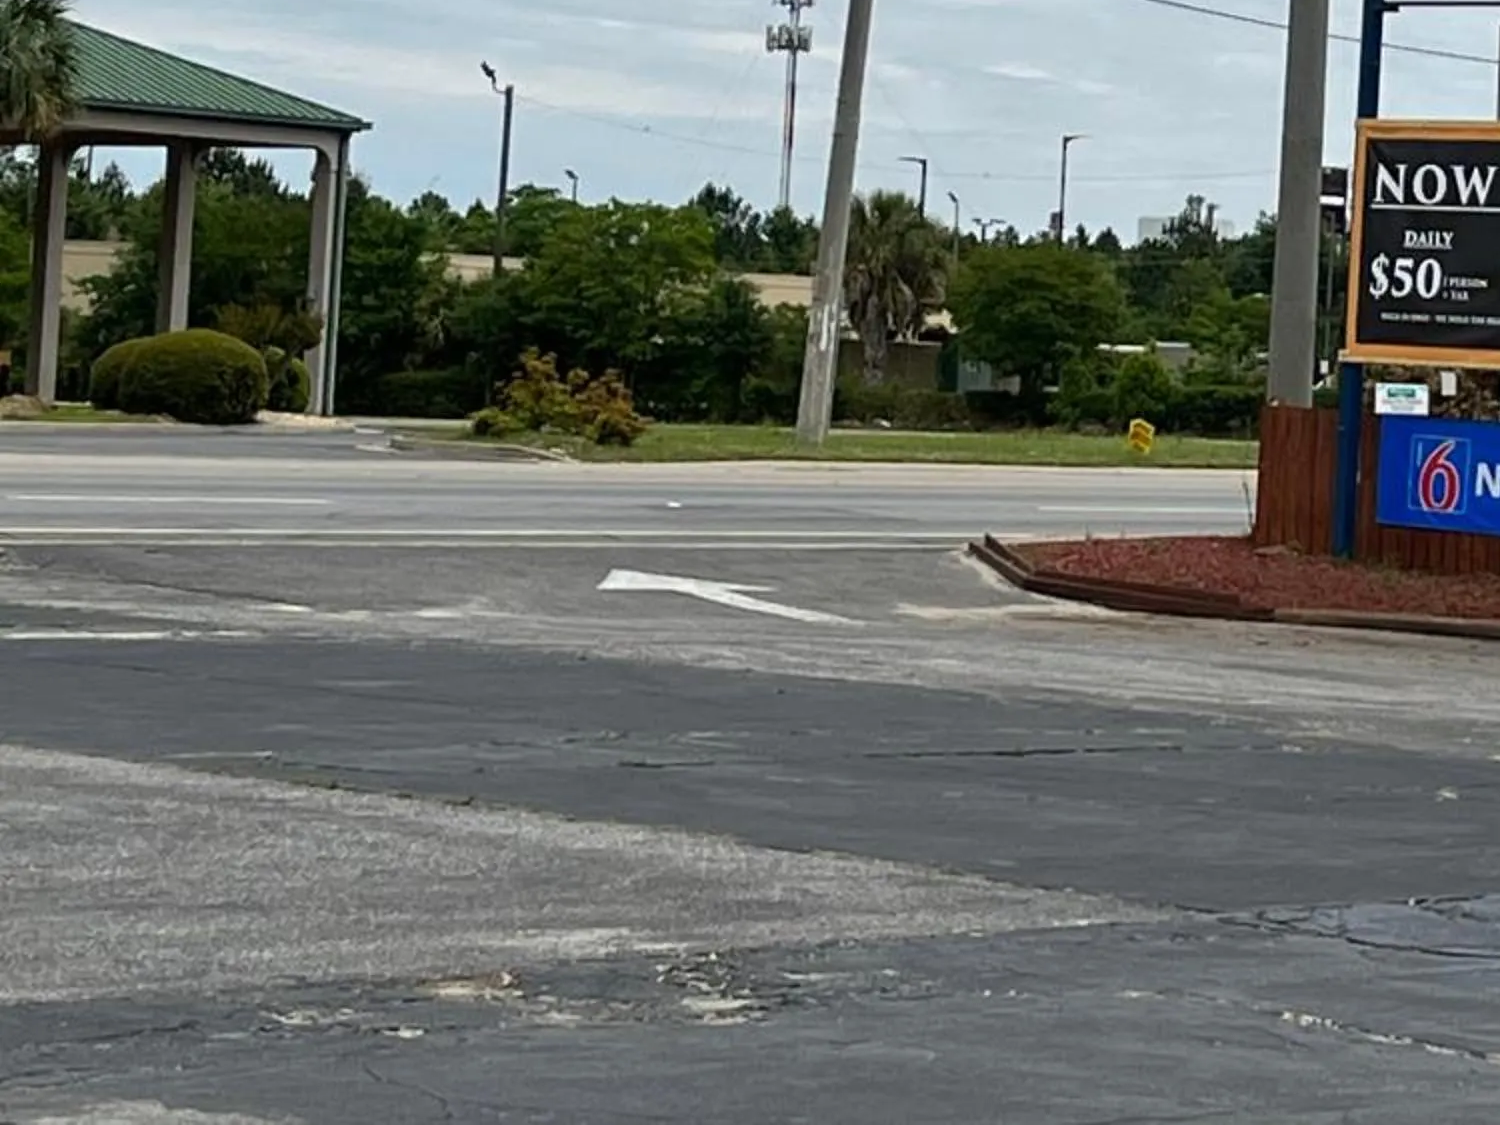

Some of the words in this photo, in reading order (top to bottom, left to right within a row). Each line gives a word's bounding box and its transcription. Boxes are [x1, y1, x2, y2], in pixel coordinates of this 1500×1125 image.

[1373, 163, 1498, 206] NOW
[1403, 230, 1454, 248] DAILY
[1369, 252, 1442, 299] $50
[1418, 439, 1460, 512] 6
